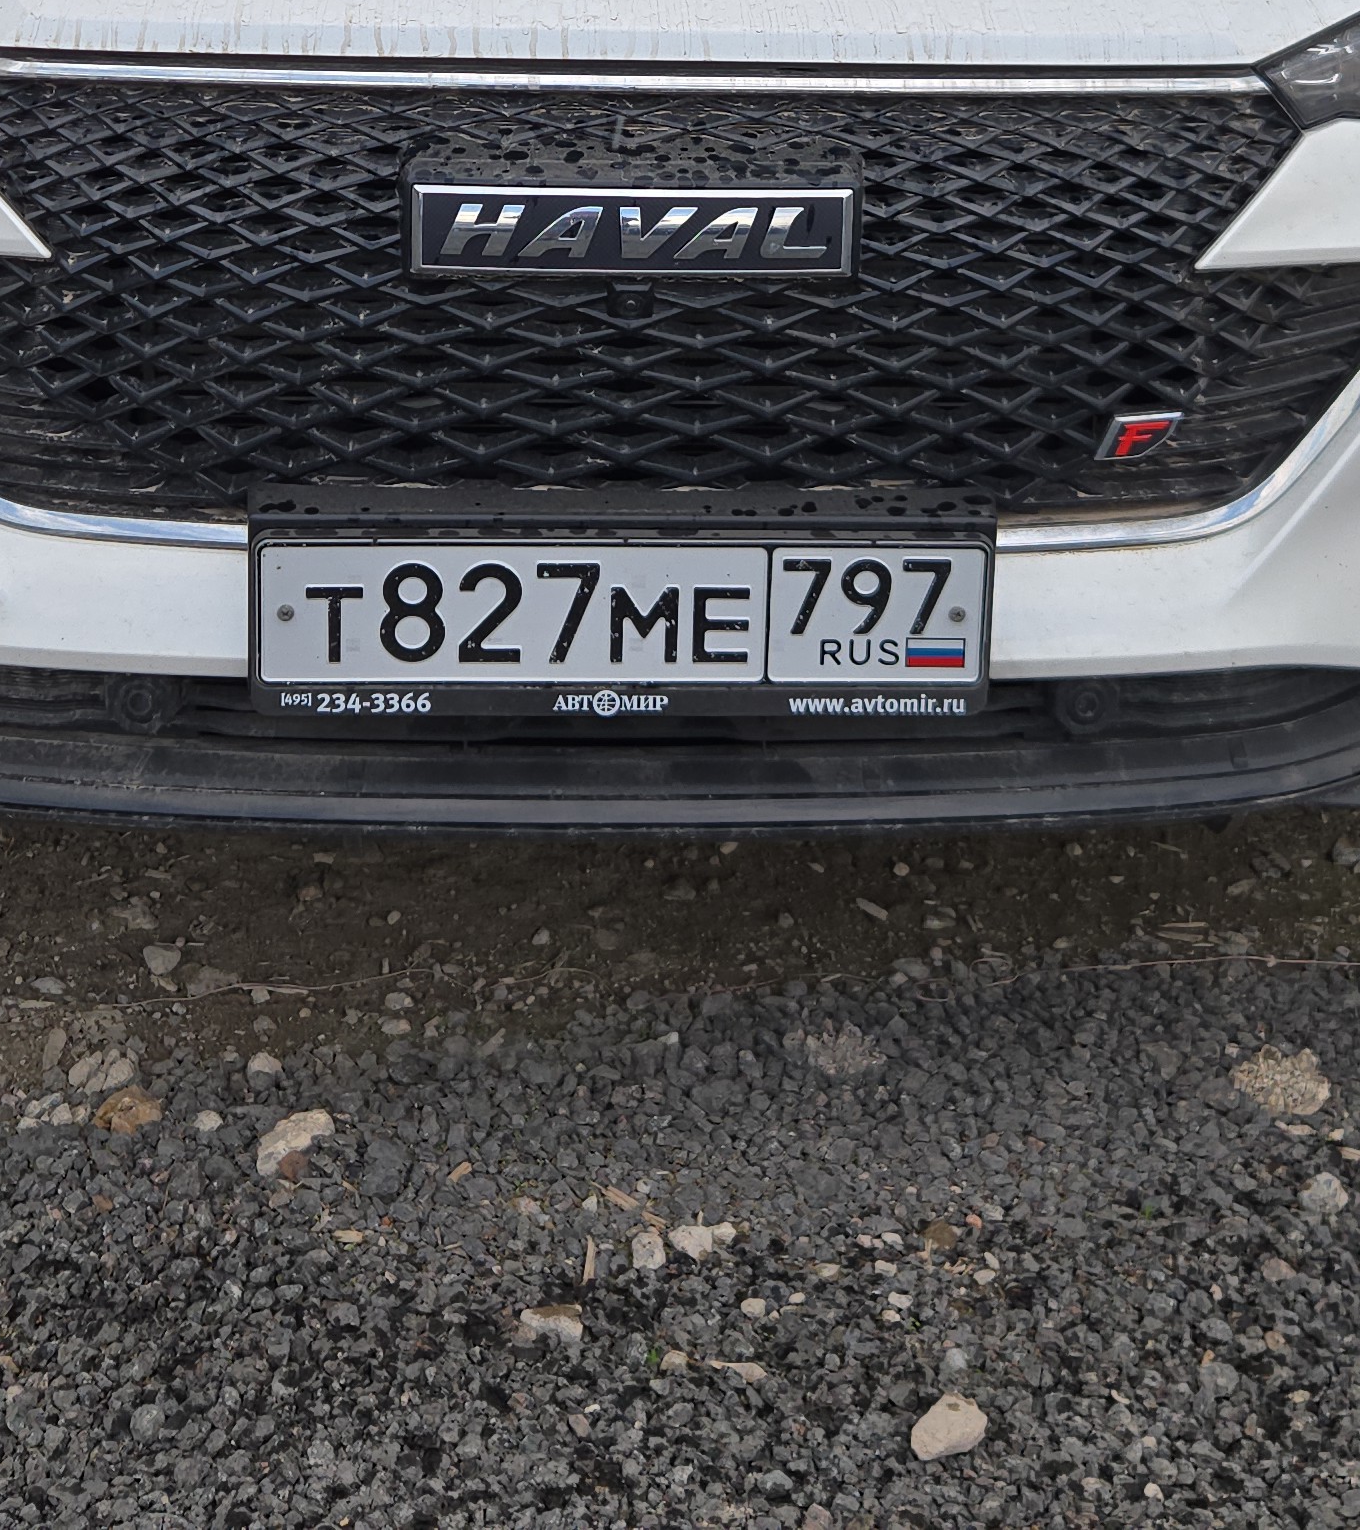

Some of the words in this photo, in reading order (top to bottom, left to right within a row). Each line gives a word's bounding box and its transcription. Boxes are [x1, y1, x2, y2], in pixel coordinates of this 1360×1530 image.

[439, 203, 830, 260] HAVAL
[1115, 420, 1170, 456] F
[782, 558, 953, 636] 797
[819, 638, 900, 666] RUS
[317, 692, 432, 713] 234-3366
[789, 694, 966, 715] www.avtomir.ru
